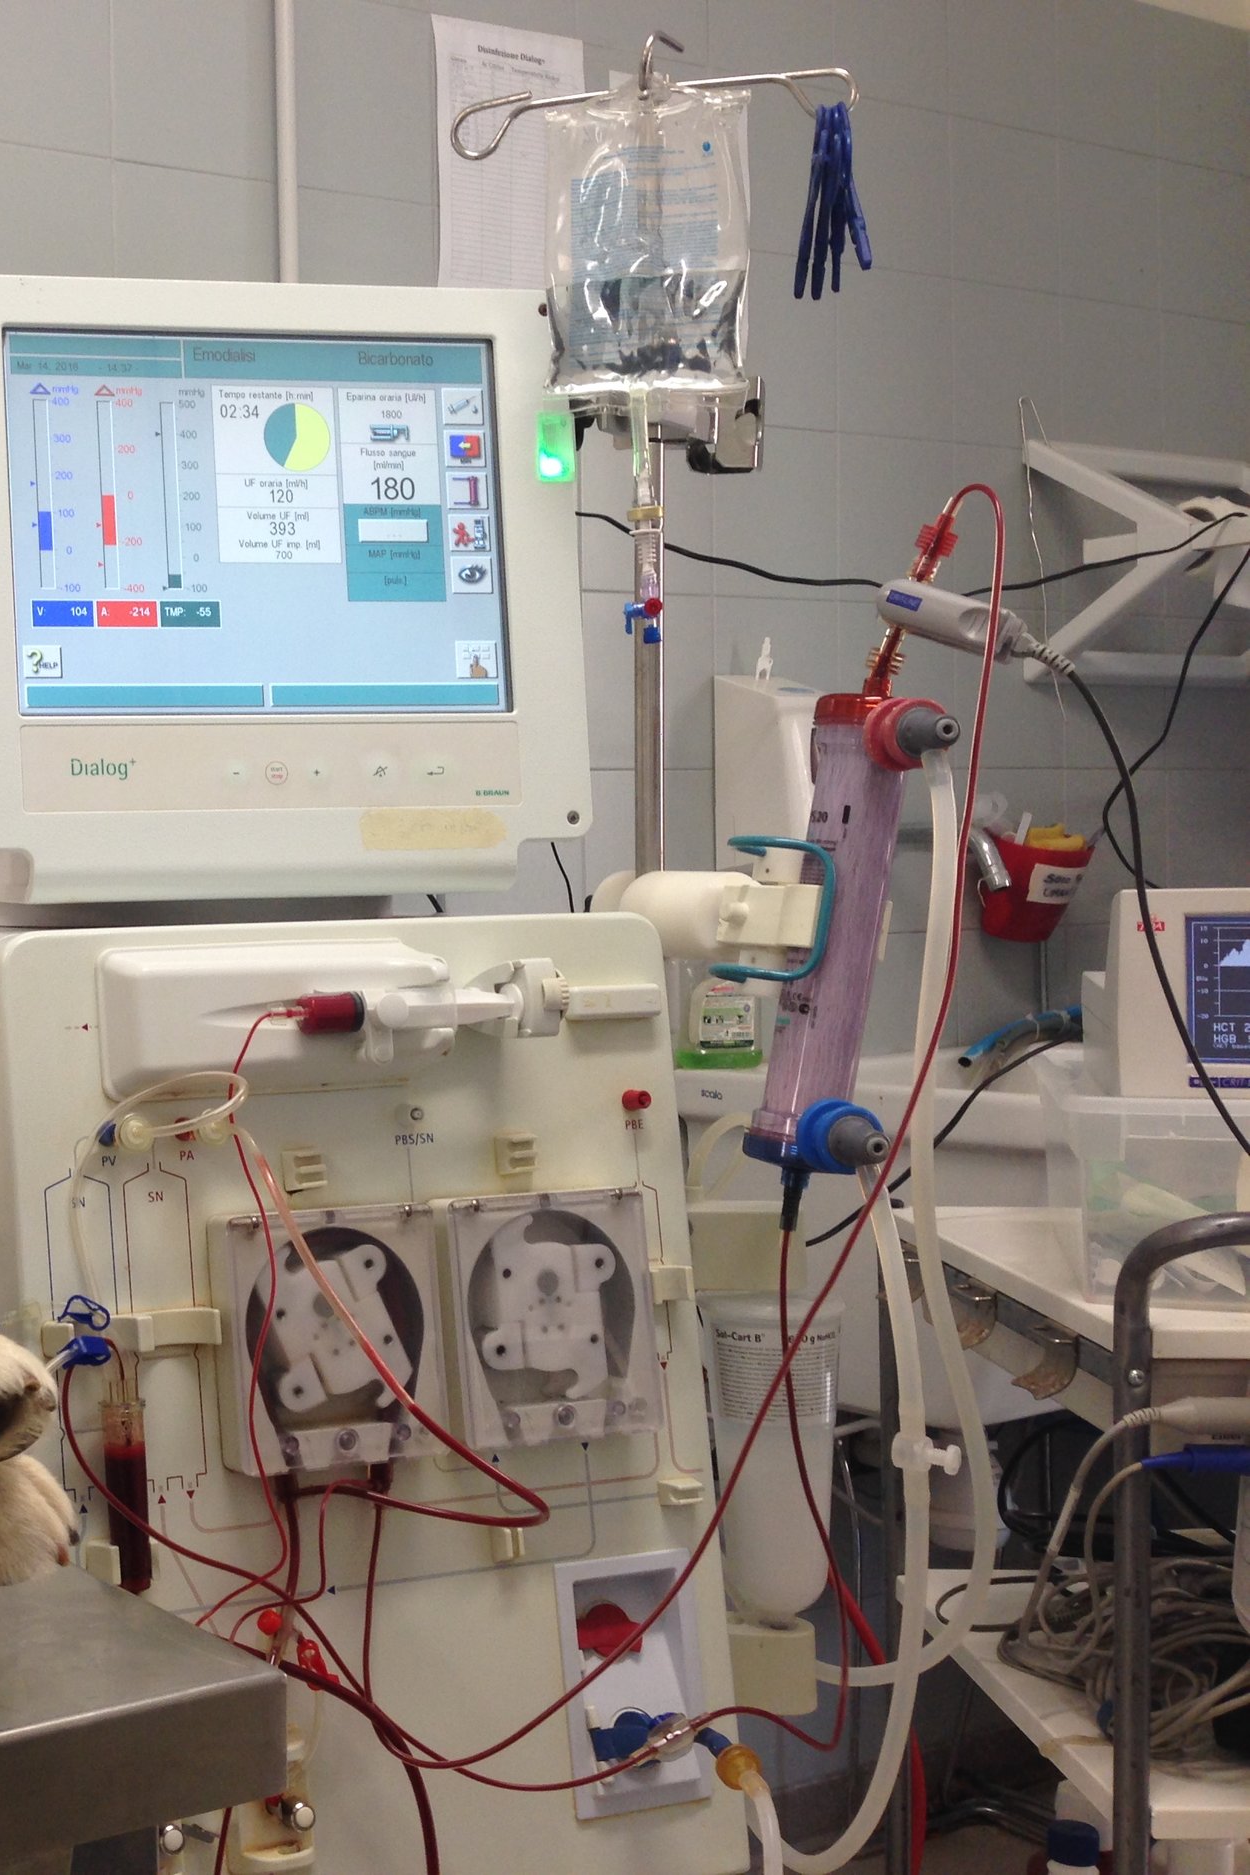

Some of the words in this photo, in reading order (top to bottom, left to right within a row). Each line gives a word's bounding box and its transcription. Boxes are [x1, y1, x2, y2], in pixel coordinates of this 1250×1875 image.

[193, 347, 256, 362] Emodialisi
[358, 350, 434, 366] Bicarbonato
[52, 385, 79, 396] mmHg
[116, 386, 143, 397] mmHg
[178, 388, 205, 399] mmHg
[219, 390, 246, 401] Tempo
[249, 390, 282, 400] restante
[52, 397, 69, 406] 400
[346, 392, 376, 402] Eparina
[116, 398, 133, 407] 400
[178, 400, 196, 409] 500
[219, 404, 260, 419] 02:34
[381, 410, 403, 419] 1800
[53, 435, 71, 443] 300
[180, 430, 197, 440] 400
[118, 445, 136, 454] 200
[360, 447, 385, 457] Flusso
[389, 449, 416, 459] sangue
[181, 461, 199, 470] 300
[55, 471, 73, 480] 200
[244, 478, 255, 487] UF
[259, 479, 283, 488] oraria
[371, 476, 415, 500] 180
[127, 491, 134, 500] 0
[183, 492, 200, 500] 200
[270, 488, 294, 503] 120
[58, 509, 75, 518] 100
[246, 511, 276, 520] Volume
[279, 511, 291, 520] UF
[294, 511, 310, 522] [ml]
[185, 522, 202, 531] 100
[269, 521, 296, 536] 393
[238, 539, 268, 548] Volume
[271, 539, 283, 548] UF
[305, 540, 321, 550] [ml]
[66, 546, 73, 555] 0
[276, 550, 293, 560] 700
[368, 550, 387, 558] MAP
[193, 553, 200, 562] 0
[70, 606, 88, 617] 104
[129, 606, 151, 617] -214
[164, 606, 186, 617] TMP:
[196, 606, 212, 617] -55
[39, 661, 59, 670] HELP
[1213, 1022, 1235, 1032] HCT
[1213, 1034, 1237, 1044] HGB
[625, 1118, 645, 1130] PBE
[394, 1132, 435, 1146] PBS/SN
[179, 1149, 195, 1161] PA
[101, 1154, 117, 1167] PV
[147, 1190, 164, 1203] SN
